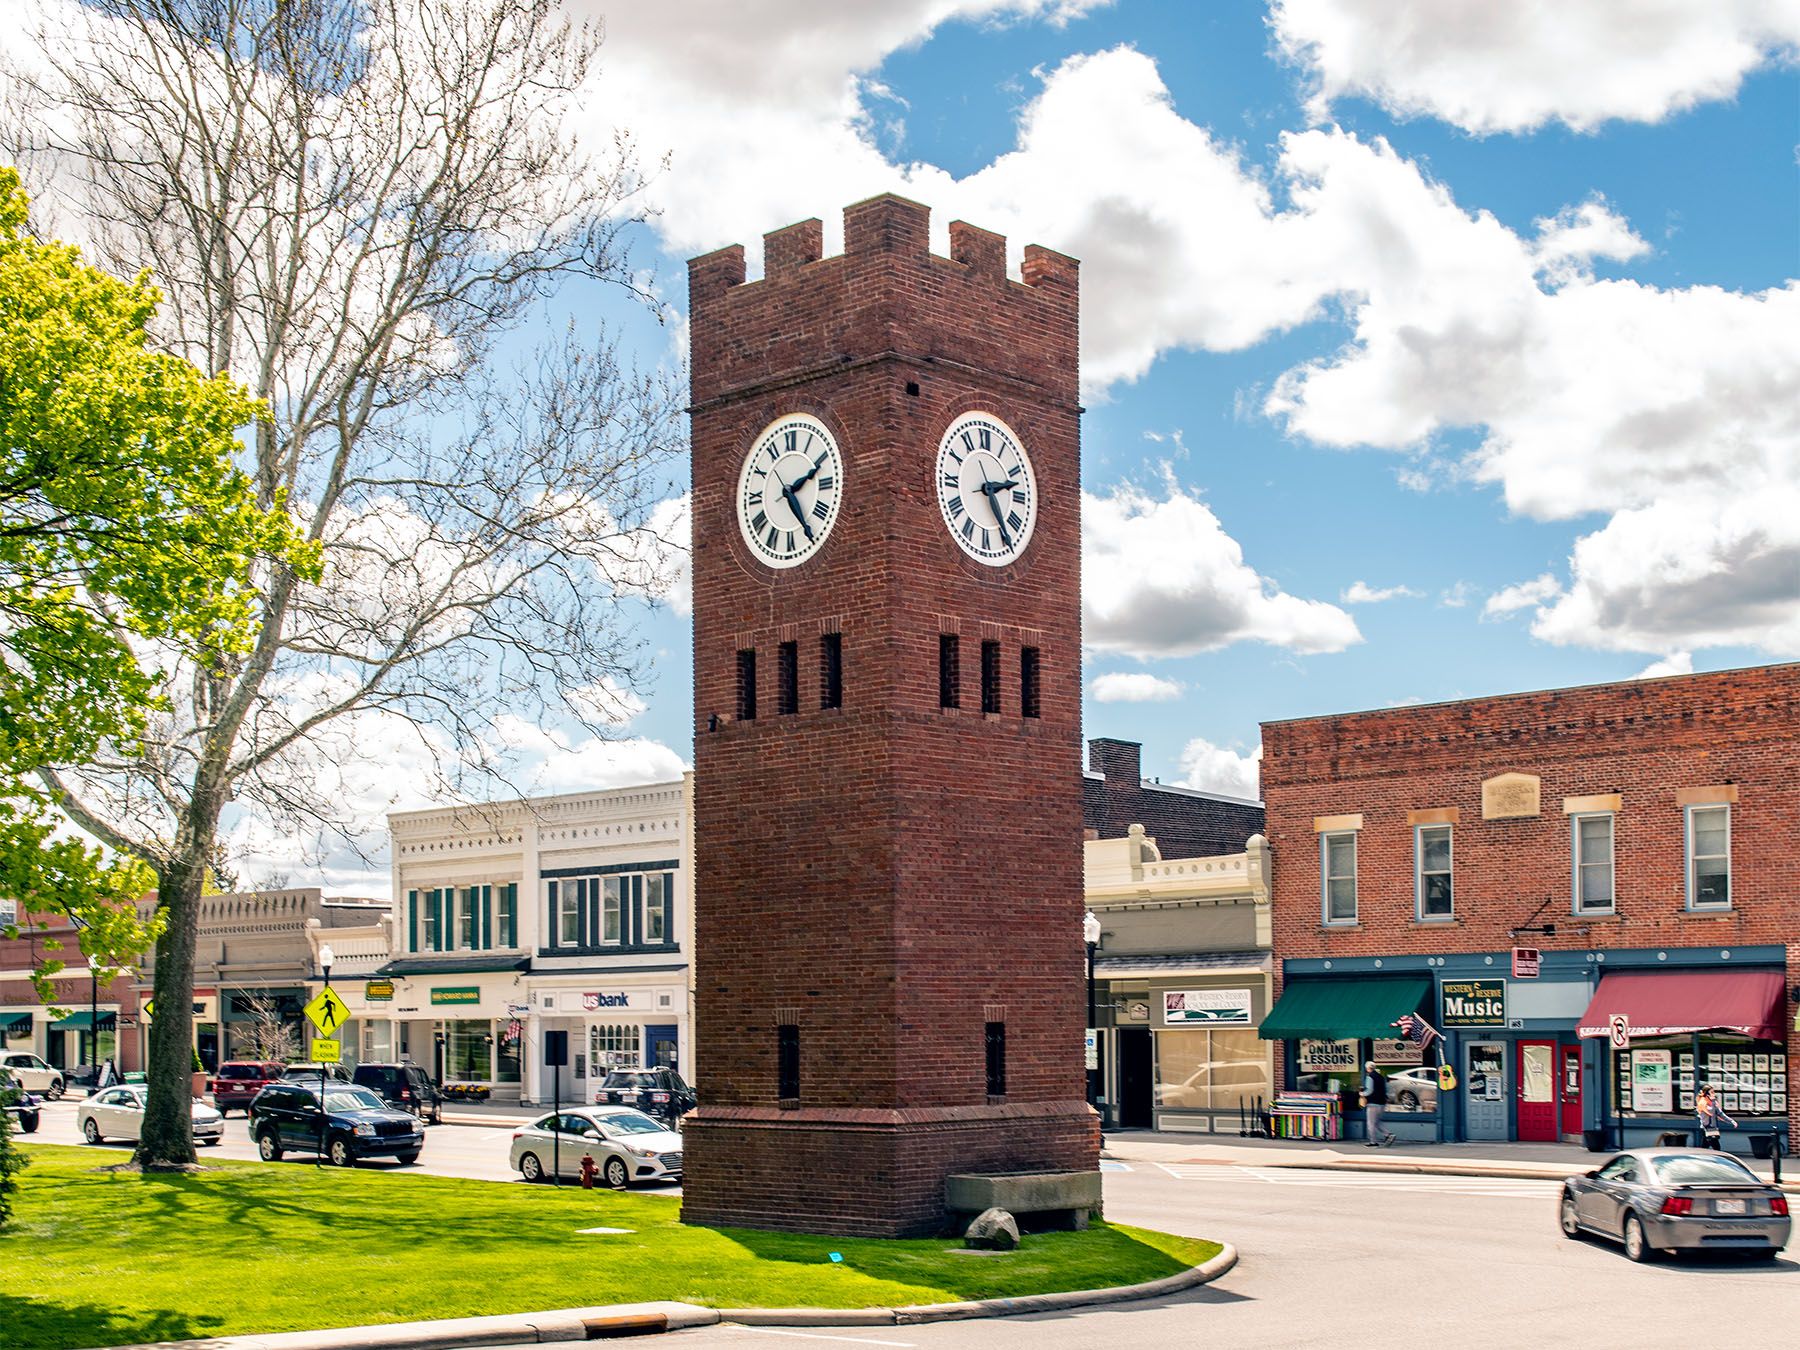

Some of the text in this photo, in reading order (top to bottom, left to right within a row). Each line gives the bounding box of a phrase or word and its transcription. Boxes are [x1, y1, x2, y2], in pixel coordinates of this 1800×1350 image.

[949, 449, 963, 466] X
[754, 466, 767, 479] X
[1444, 984, 1502, 998] WESTERN RESERVE
[1445, 997, 1503, 1017] Music
[1308, 1044, 1350, 1054] ONLINE
[1304, 1054, 1355, 1065] LESSONS
